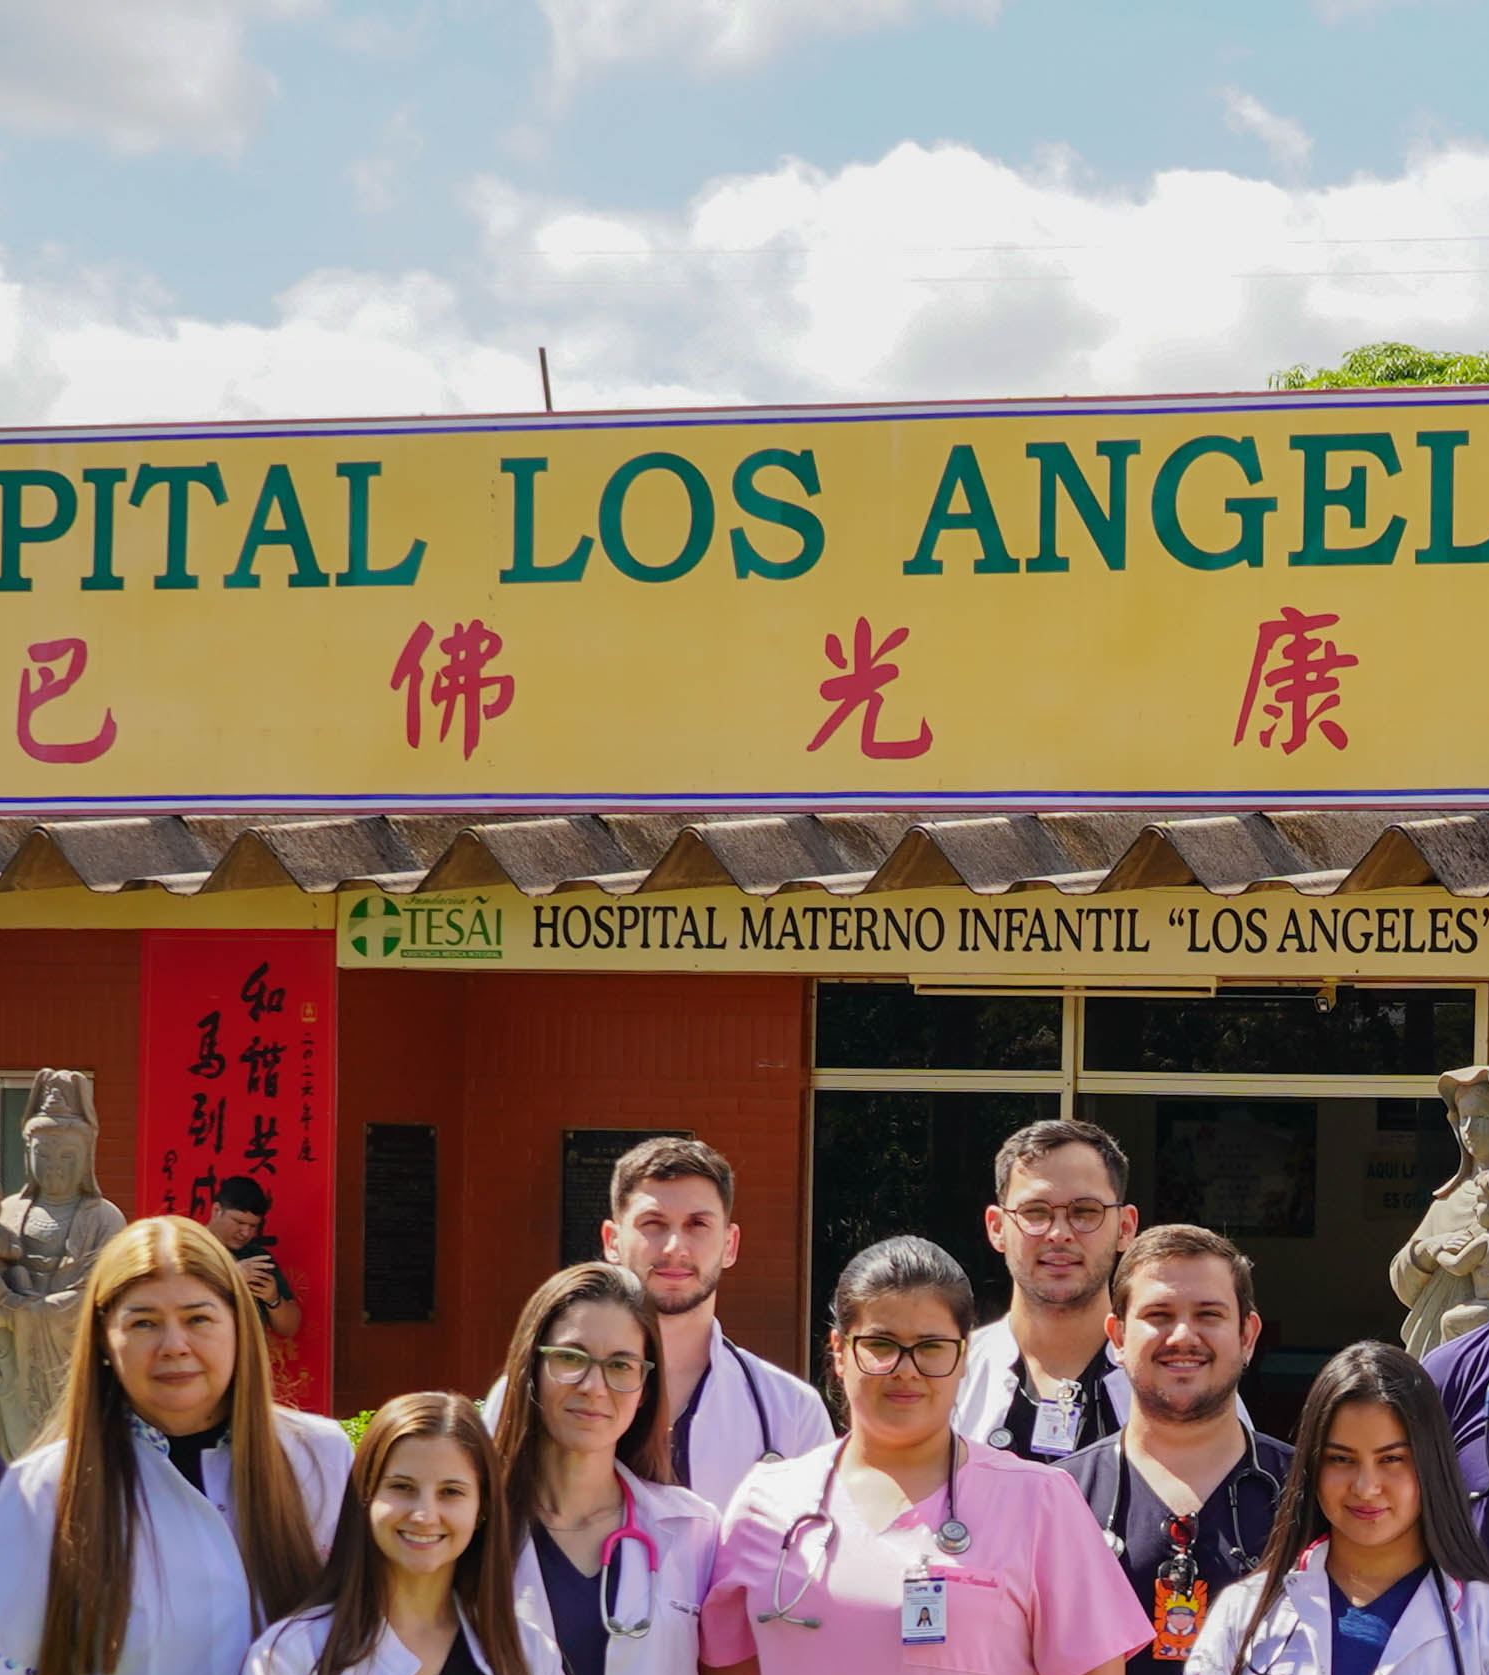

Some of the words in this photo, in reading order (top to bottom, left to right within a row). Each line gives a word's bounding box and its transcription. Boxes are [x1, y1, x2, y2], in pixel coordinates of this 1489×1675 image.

[498, 448, 826, 584] LOS
[533, 904, 727, 950] HOSPITAL
[739, 906, 945, 952] MATERNO
[958, 907, 1150, 953] INFANTIL
[1168, 907, 1268, 954] “LOS
